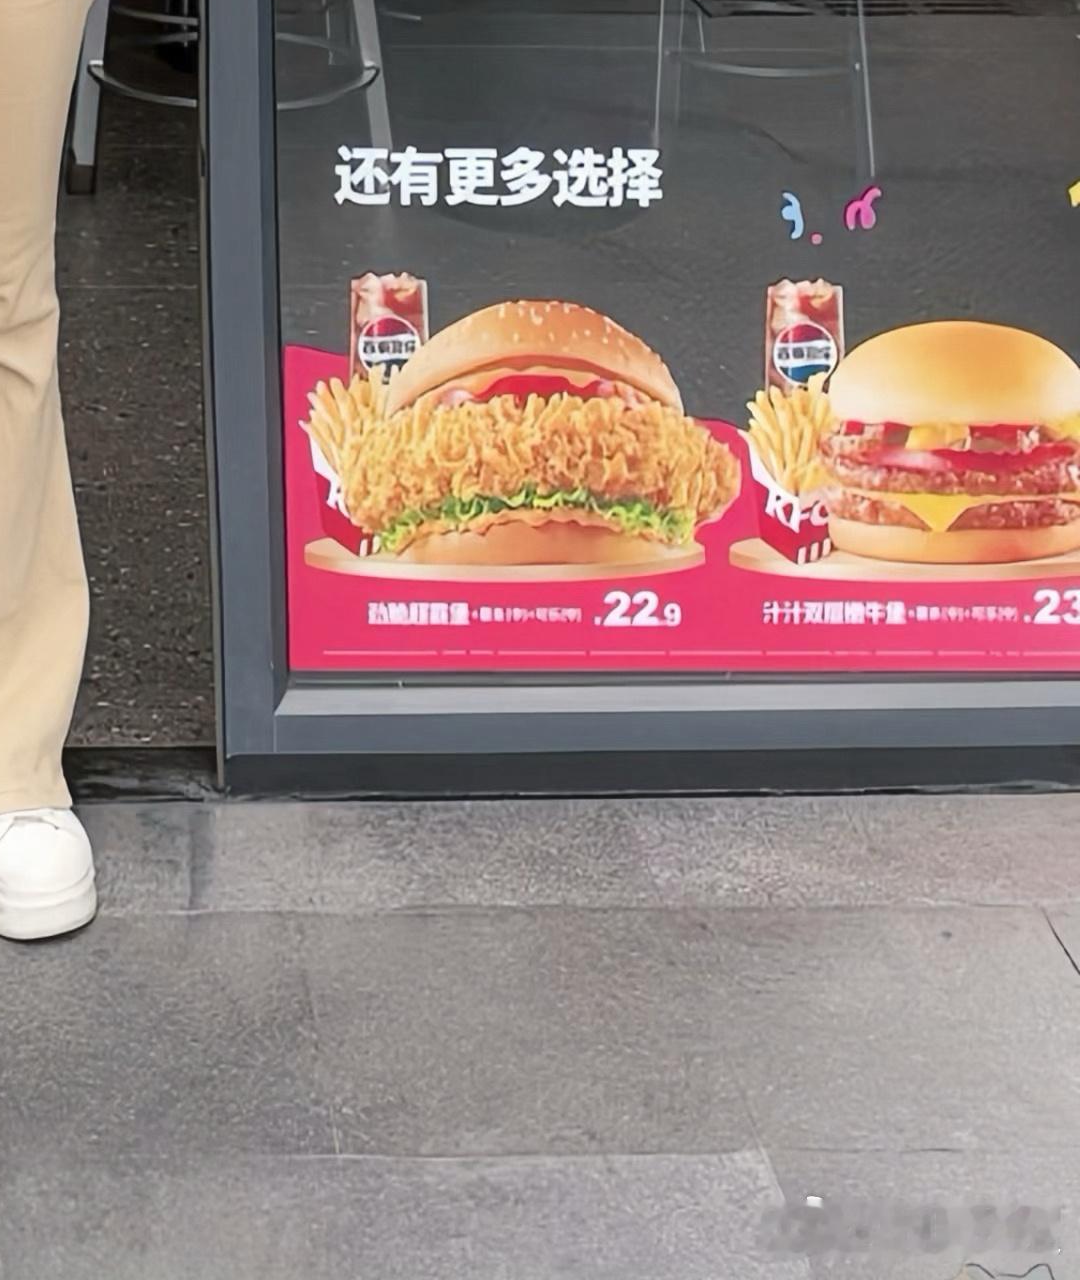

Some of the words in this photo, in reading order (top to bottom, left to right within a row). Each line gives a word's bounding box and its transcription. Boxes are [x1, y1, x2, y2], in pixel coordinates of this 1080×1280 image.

[334, 145, 664, 207] 还有更多选择
